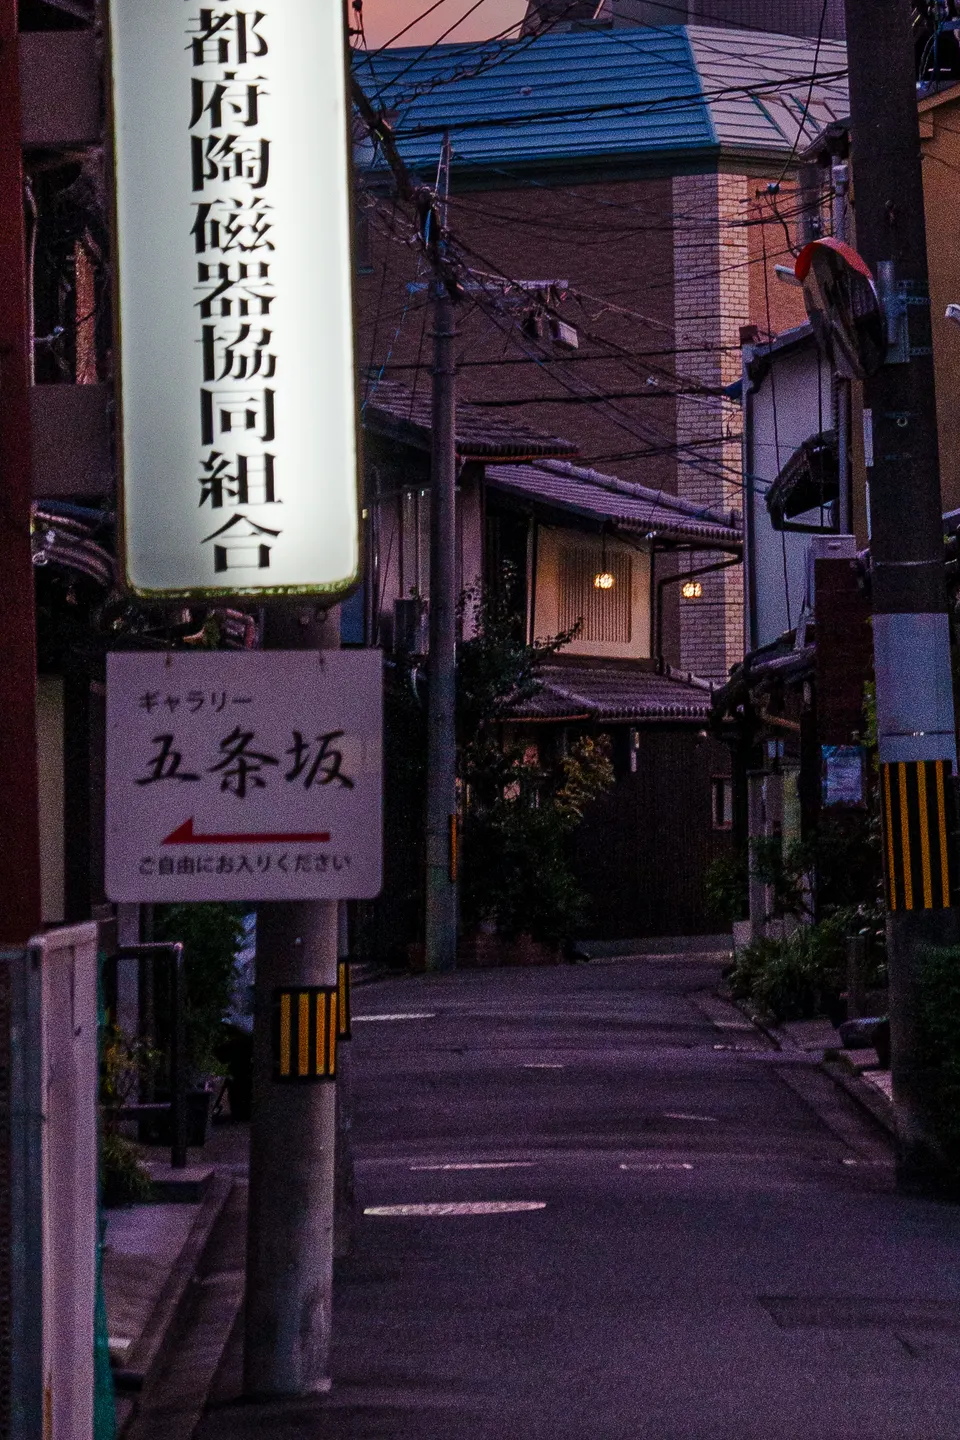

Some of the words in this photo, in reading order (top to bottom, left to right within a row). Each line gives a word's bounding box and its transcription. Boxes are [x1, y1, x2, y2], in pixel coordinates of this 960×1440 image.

[138, 691, 252, 713] ギャラリー
[135, 726, 354, 798] 五条坂
[138, 854, 351, 876] ご自由にお入りください
